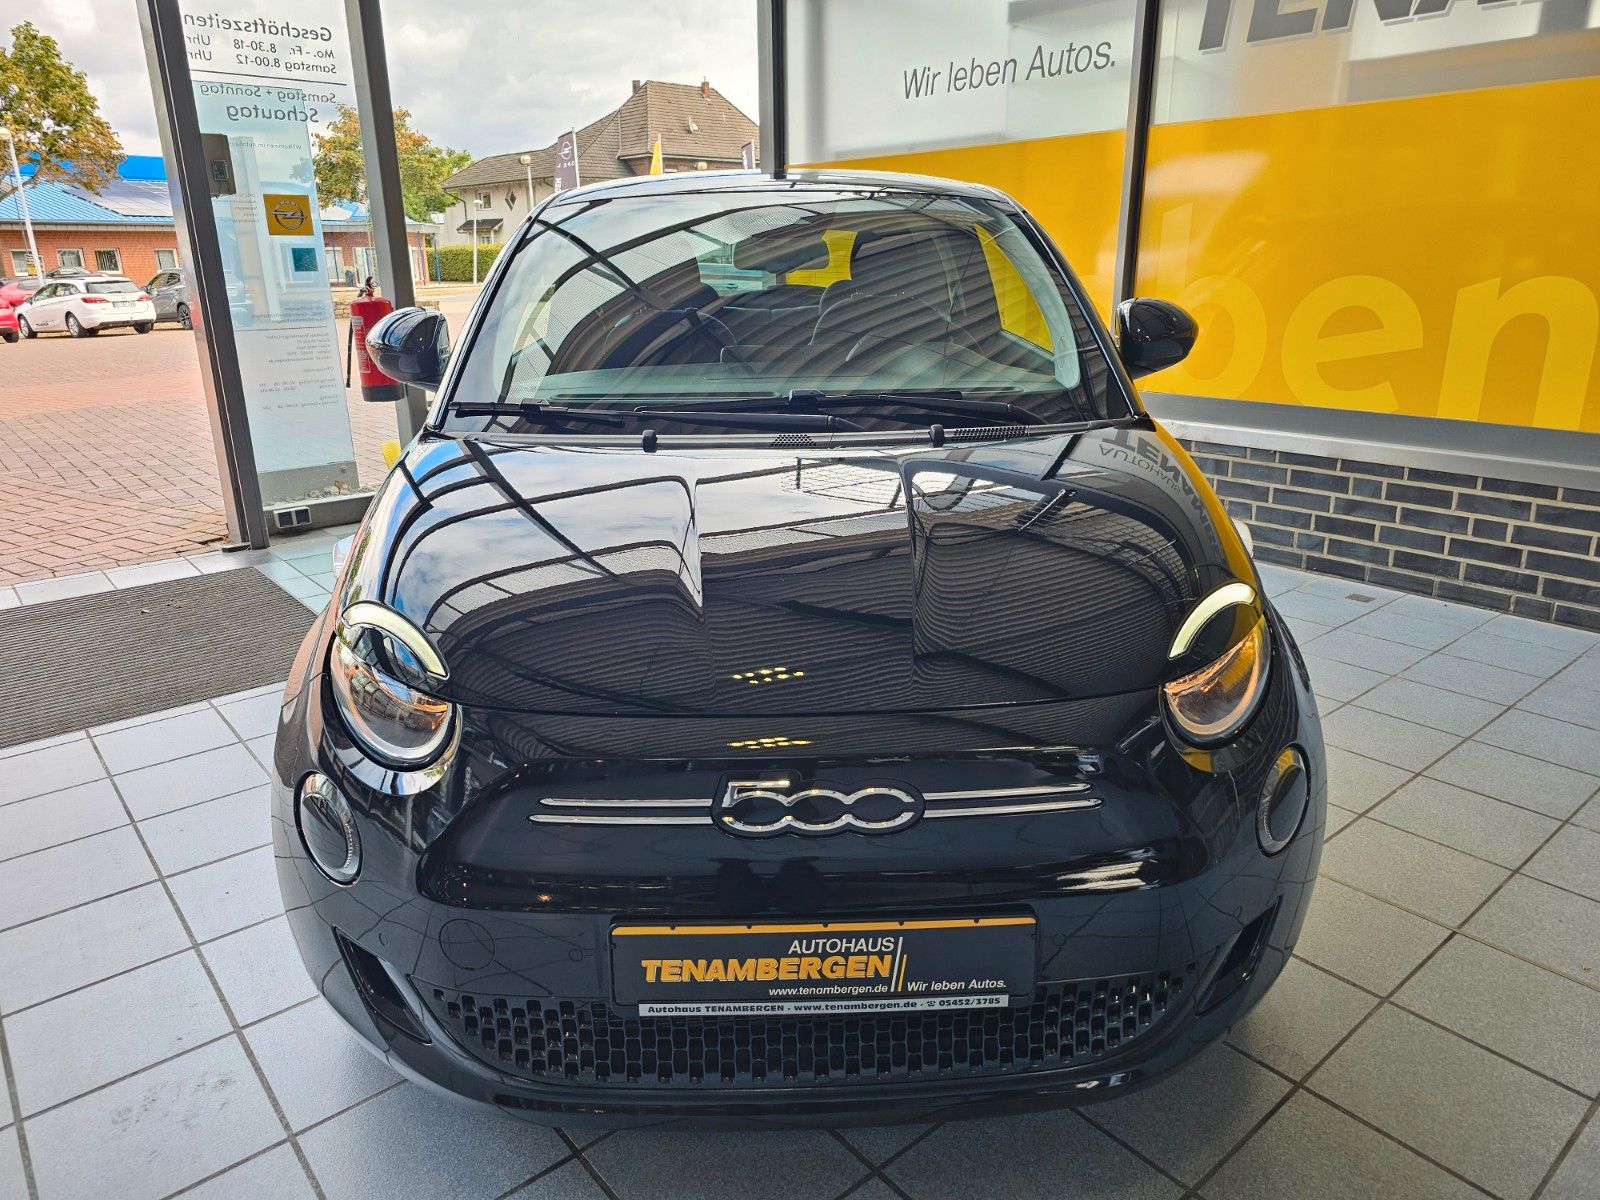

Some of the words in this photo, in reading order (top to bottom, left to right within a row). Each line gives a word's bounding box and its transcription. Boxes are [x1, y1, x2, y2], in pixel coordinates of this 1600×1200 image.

[904, 66, 941, 99] Wir
[947, 57, 1018, 93] leben
[1025, 41, 1115, 81] Autos.
[721, 780, 915, 832] 500
[788, 937, 895, 954] AUTOHAUS
[641, 954, 893, 983] TENAMBERGEN
[769, 984, 888, 996] www.tenambergen.de
[907, 981, 928, 991] Wir
[931, 980, 965, 991] leben
[968, 979, 1007, 990] Autos.
[648, 1005, 702, 1014] Autohaus
[704, 1004, 785, 1013] TENAMBERGEN
[794, 1000, 917, 1011] www.tenambergen.de
